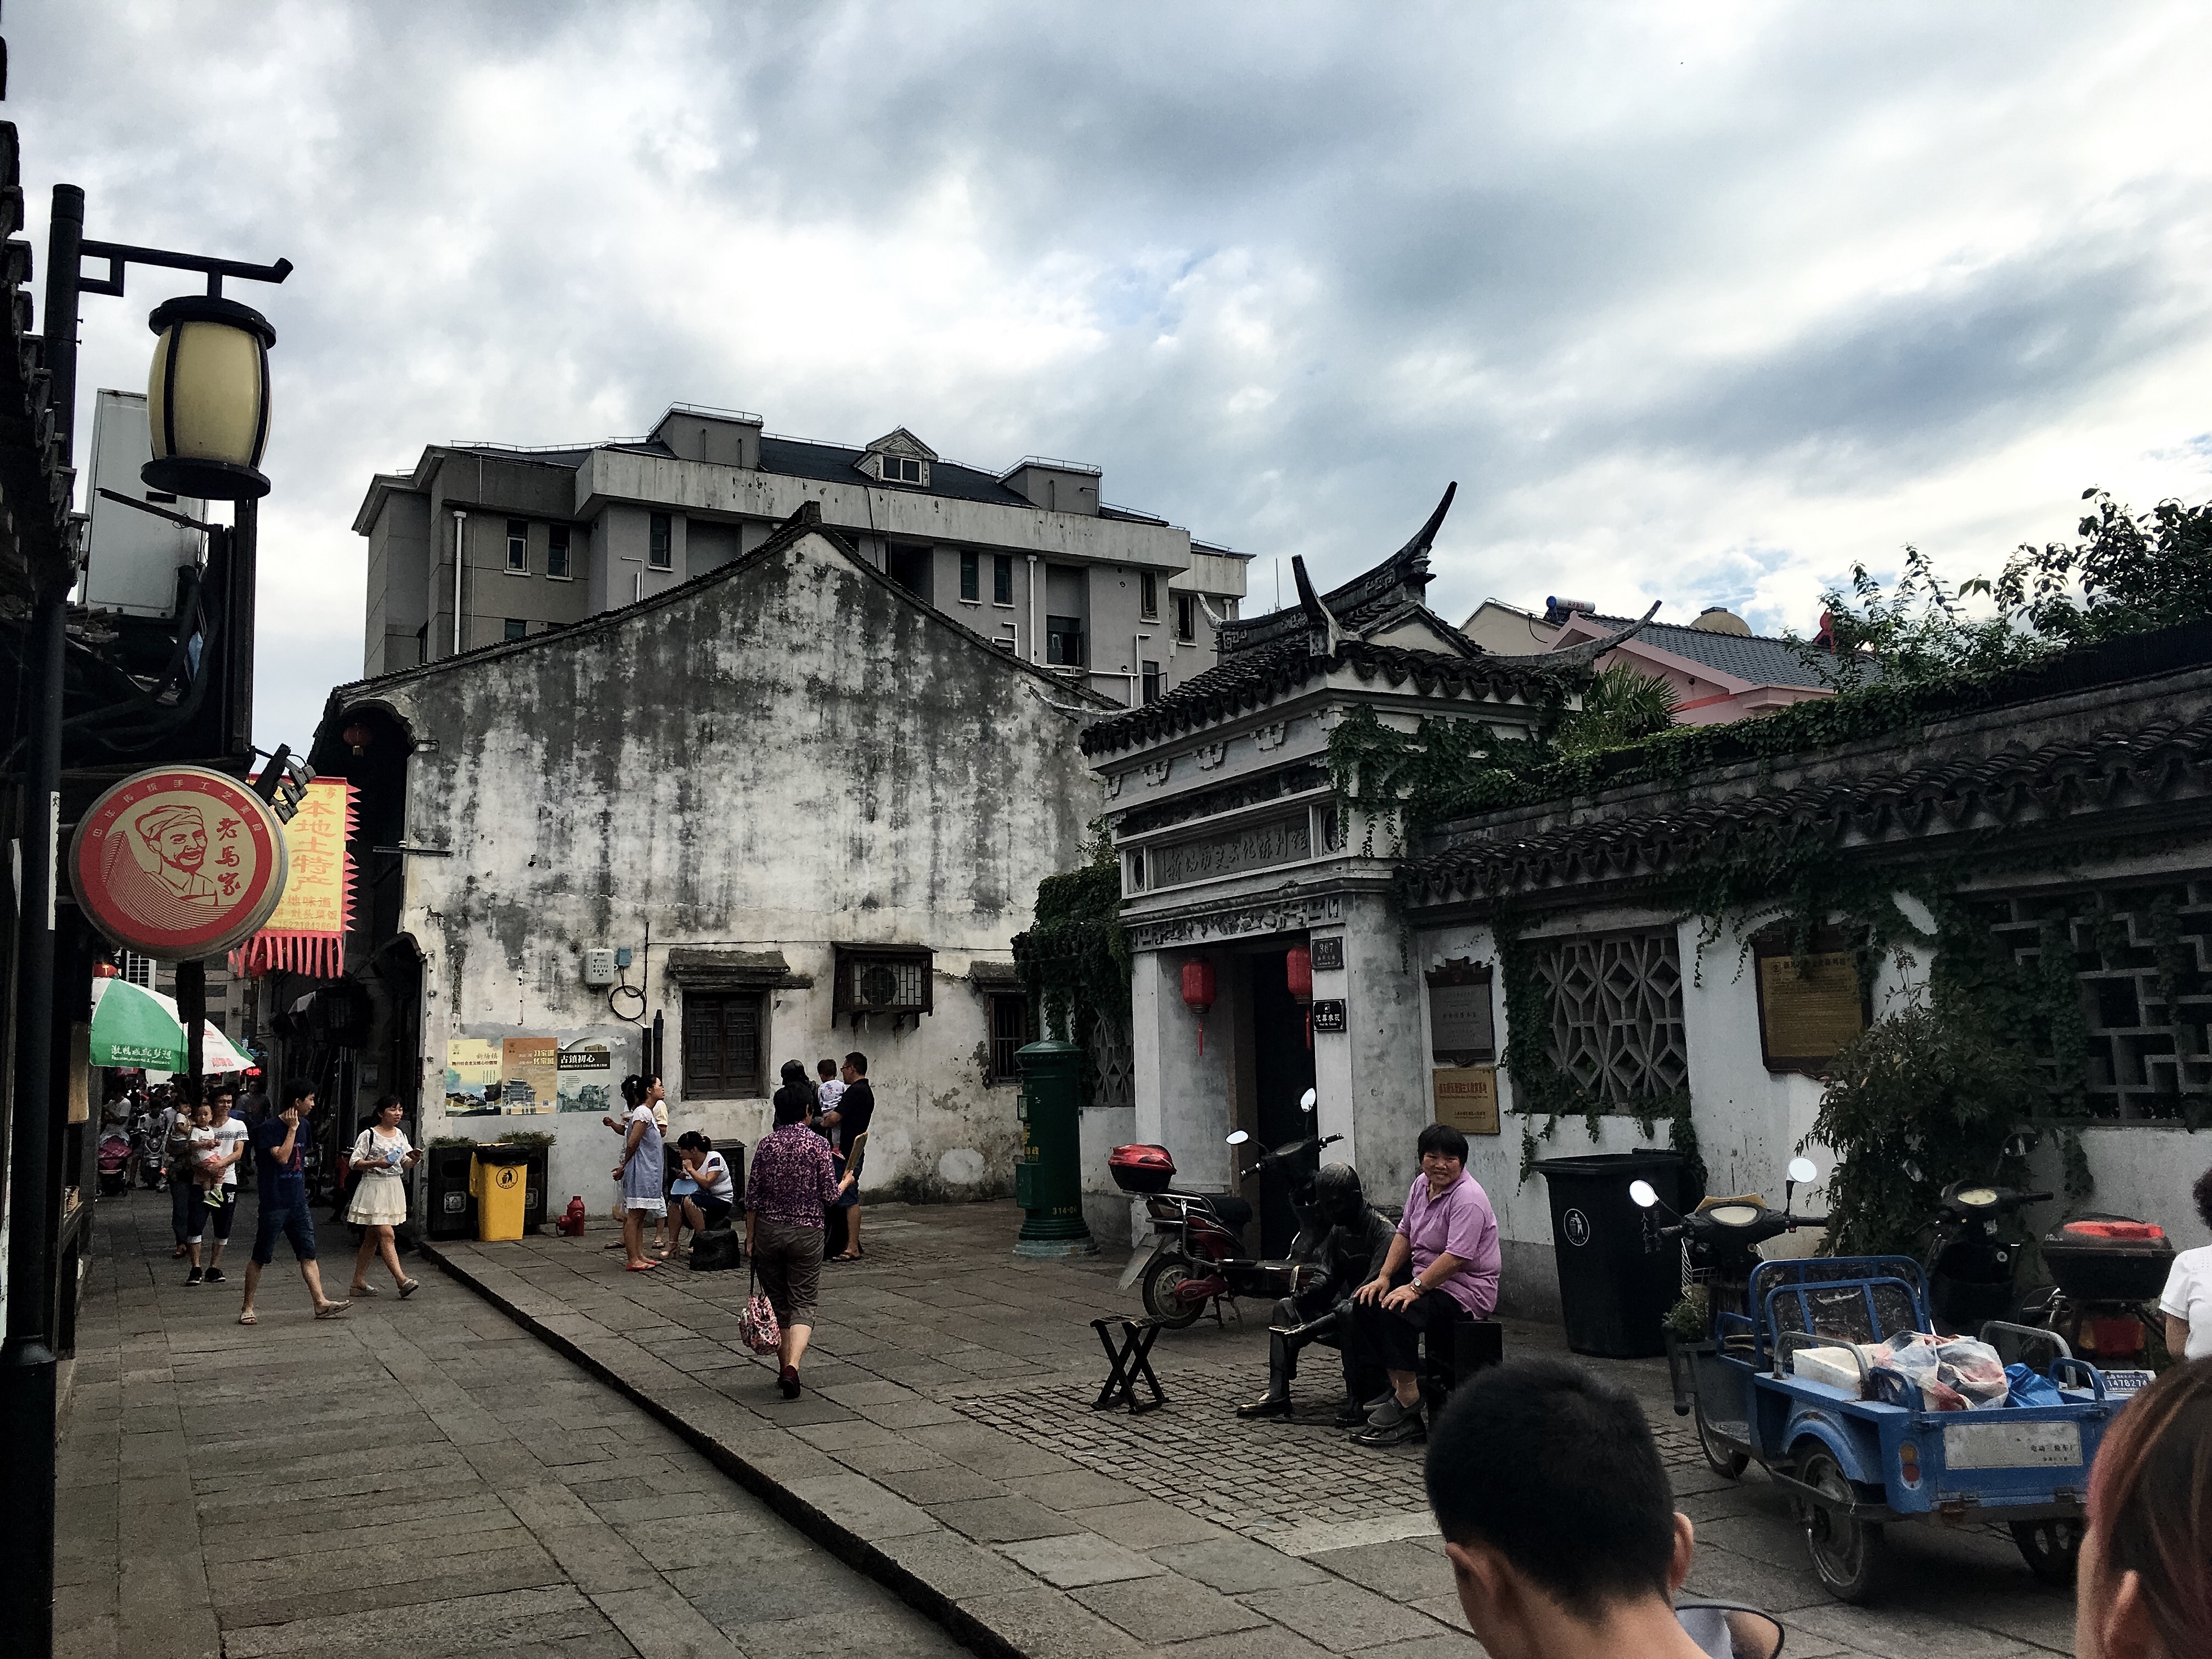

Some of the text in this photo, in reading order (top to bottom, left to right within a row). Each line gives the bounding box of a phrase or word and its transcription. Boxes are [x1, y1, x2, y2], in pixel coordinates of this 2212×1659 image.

[291, 800, 336, 891] 本地土特产
[560, 1054, 595, 1064] 古镇初心
